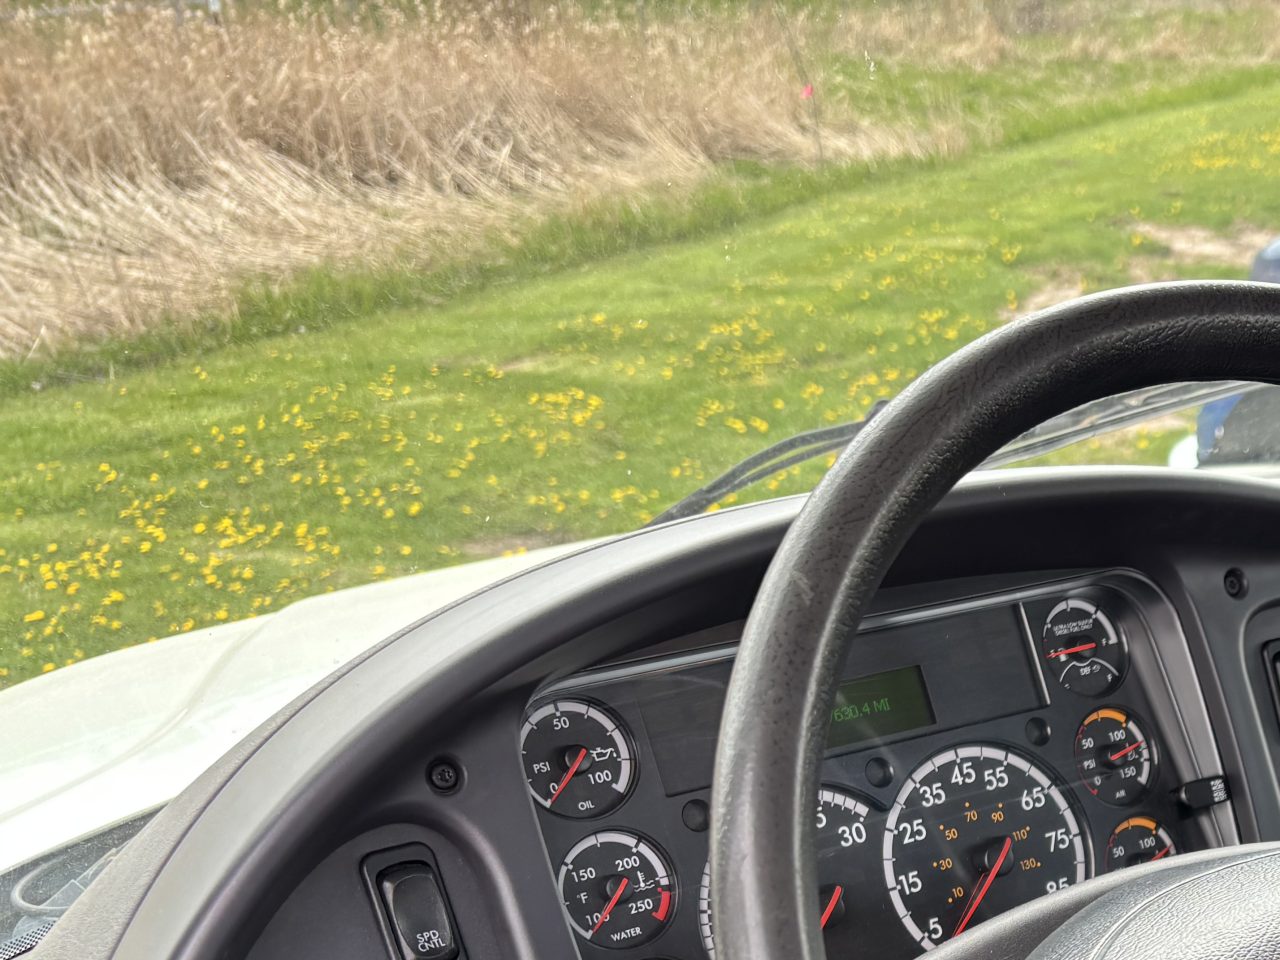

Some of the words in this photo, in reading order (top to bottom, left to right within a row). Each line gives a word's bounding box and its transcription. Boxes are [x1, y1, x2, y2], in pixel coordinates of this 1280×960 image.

[553, 717, 570, 730] 50
[1108, 729, 1126, 743] 100
[1081, 738, 1094, 750] 50
[533, 761, 551, 774] PSI
[1083, 760, 1096, 771] PSI
[588, 769, 612, 785] 100
[951, 762, 976, 786] 45
[984, 766, 1009, 791] 55
[1120, 766, 1137, 779] 150
[549, 782, 559, 794] 0
[919, 783, 946, 807] 35
[1021, 787, 1046, 811] 65
[578, 800, 595, 811] OIL
[964, 810, 978, 822] 70
[991, 810, 1004, 823] 90
[838, 822, 867, 847] 30
[899, 819, 927, 845] 25
[945, 828, 958, 841] 50
[1012, 830, 1028, 842] 110
[1045, 828, 1070, 853] 75
[1139, 837, 1156, 850] 100
[1113, 846, 1125, 858] 50
[615, 856, 640, 872] 200
[939, 858, 953, 871] 30
[1020, 858, 1036, 871] 130
[571, 867, 596, 882] 150
[899, 870, 923, 896] 15
[952, 886, 964, 898] 10
[629, 898, 653, 915] 250
[611, 927, 642, 942] WATER
[929, 917, 943, 939] 5
[416, 930, 439, 943] SPD
[418, 937, 446, 952] CNTL
